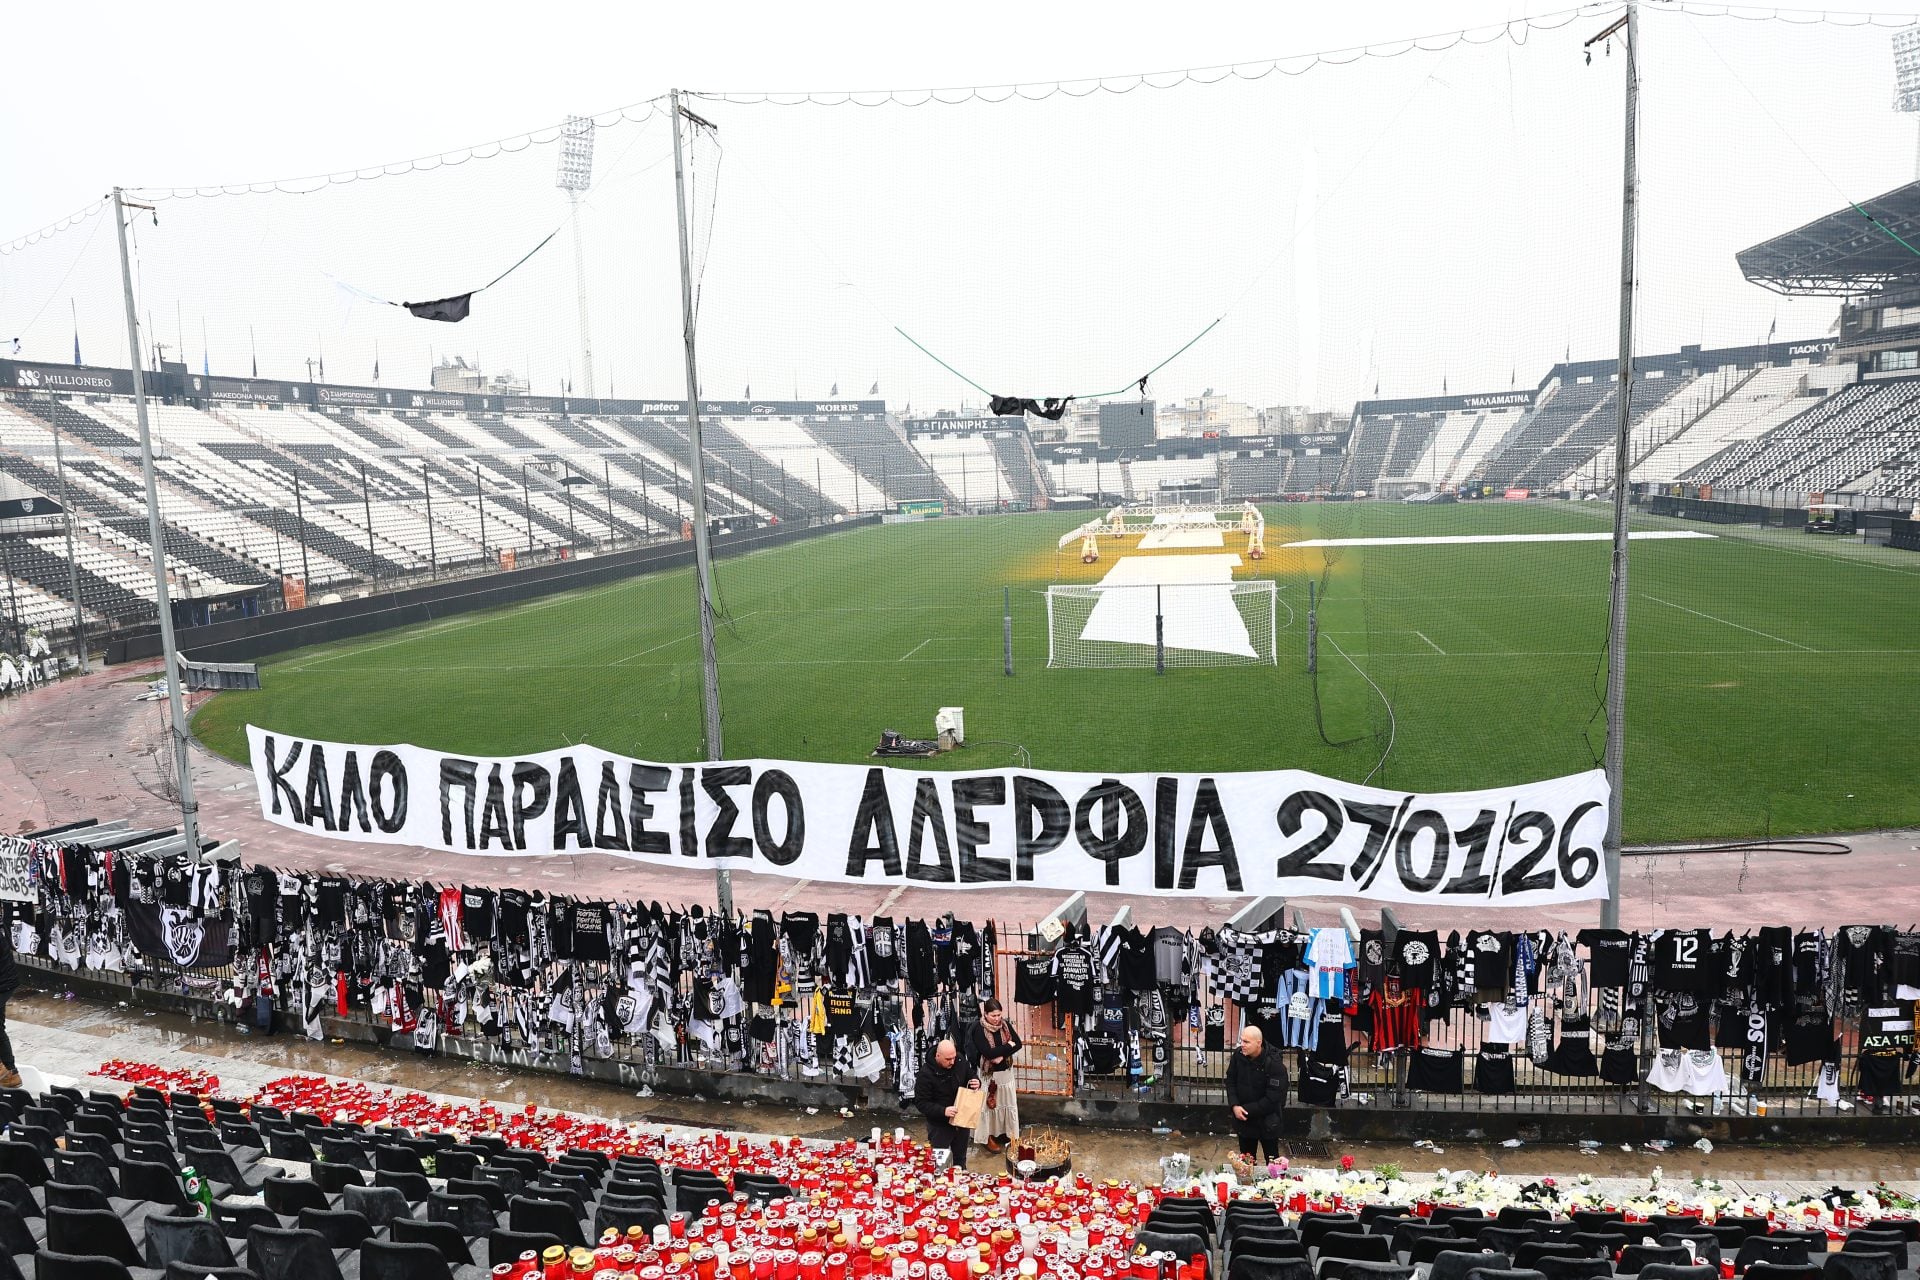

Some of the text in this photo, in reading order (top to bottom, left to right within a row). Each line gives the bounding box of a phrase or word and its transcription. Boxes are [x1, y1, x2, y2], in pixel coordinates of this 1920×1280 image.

[1789, 343, 1836, 355] ΠΑΟΚ TV
[44, 375, 112, 388] MILLIONERO
[212, 391, 253, 400] MAKEDONIA
[642, 403, 680, 413] mateco
[816, 403, 858, 412] MORRIS
[931, 420, 988, 431] ΓΙΑΝΝΙΡΗΣ
[264, 735, 1602, 900] ΚΑΛΟ ΠΑΡΑΔΕΙΣΟ ΑΔΕΡΦΙΑ 27/01/26
[1673, 936, 1698, 962] 12
[831, 999, 851, 1007] ΠΟΤΕ
[1864, 1036, 1891, 1047] ΑΣΑ
